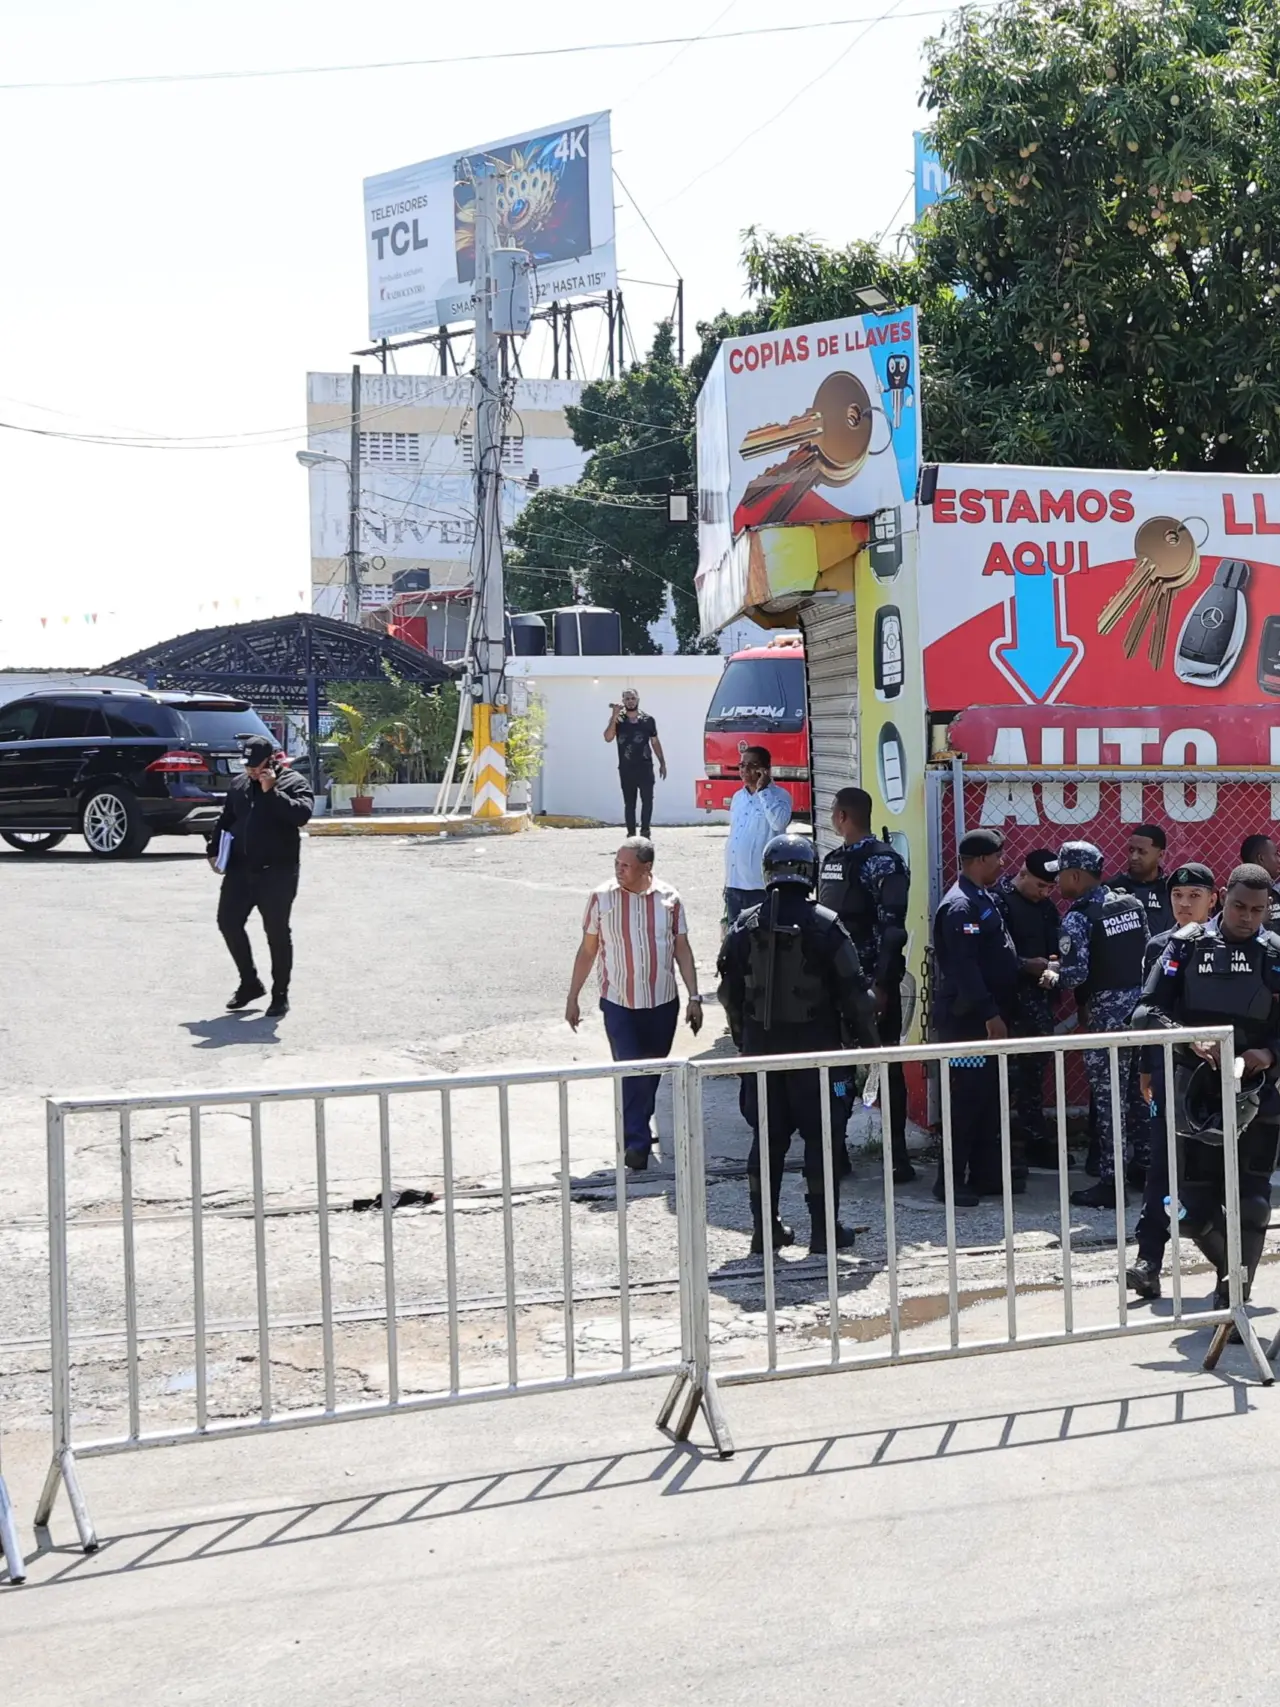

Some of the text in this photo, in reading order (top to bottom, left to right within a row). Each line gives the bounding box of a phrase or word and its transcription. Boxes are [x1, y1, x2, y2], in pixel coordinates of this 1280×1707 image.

[554, 129, 587, 162] 4K
[371, 194, 428, 222] TELEVISORES
[371, 218, 428, 260] TCL
[451, 300, 476, 315] SMAR
[552, 277, 586, 293] HASTA
[729, 321, 912, 374] COPIAS DE LLAVES
[932, 489, 1135, 524] ESTAMOS
[981, 541, 1090, 576] AQUI
[720, 706, 735, 717] LA
[980, 727, 1218, 827] AUTO
[1103, 911, 1140, 928] POLICÍA
[1105, 919, 1142, 937] NACIONAL
[1198, 962, 1252, 974] NANAL
